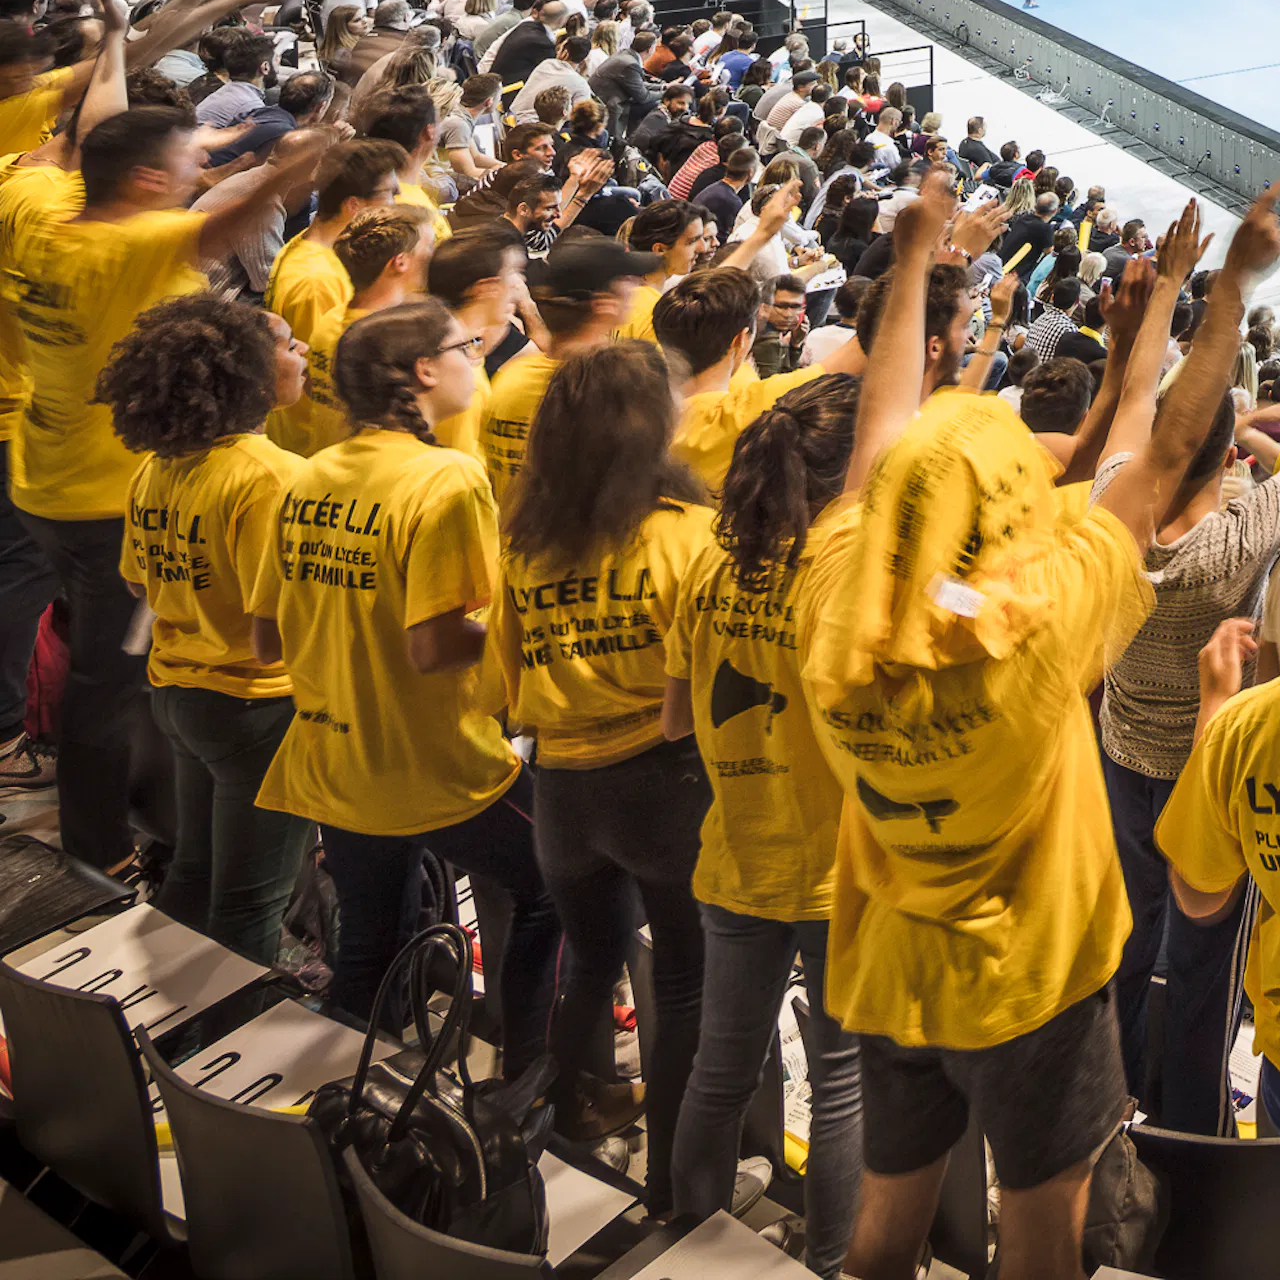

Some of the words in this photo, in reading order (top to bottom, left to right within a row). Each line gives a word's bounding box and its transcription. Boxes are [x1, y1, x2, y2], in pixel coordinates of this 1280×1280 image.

[282, 492, 344, 528] LYCÉE
[345, 499, 381, 536] L.I.
[299, 540, 333, 559] QU'UN
[335, 547, 377, 568] LYCÉE,
[301, 562, 376, 590] FAMILLE
[508, 570, 599, 613] LYCÉE
